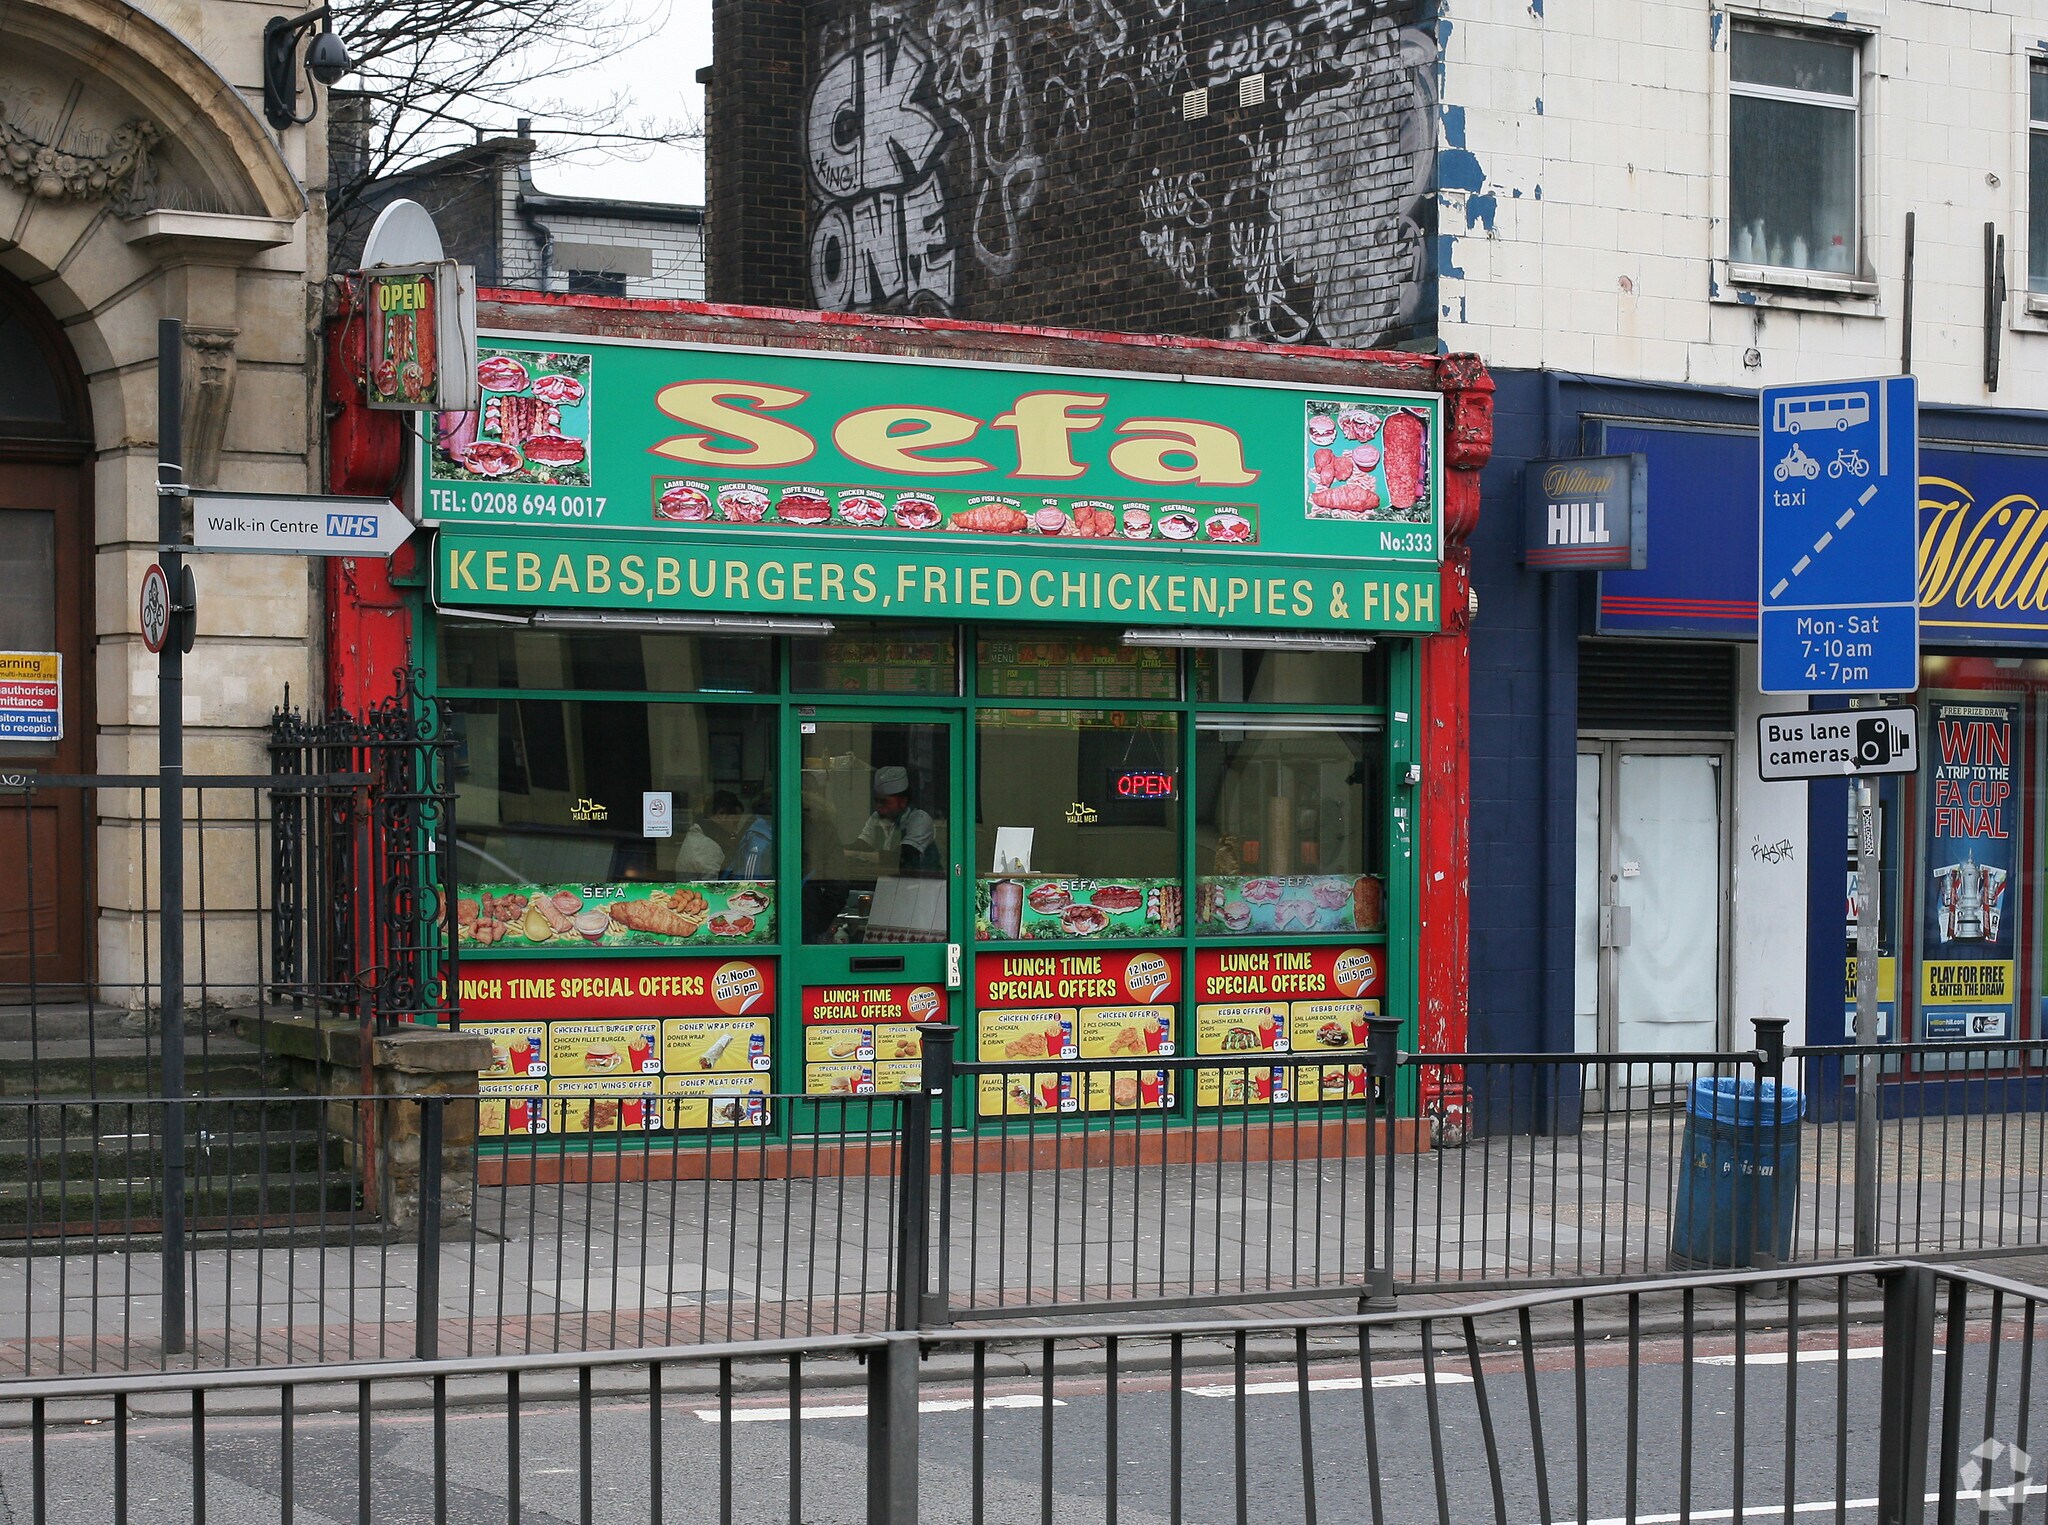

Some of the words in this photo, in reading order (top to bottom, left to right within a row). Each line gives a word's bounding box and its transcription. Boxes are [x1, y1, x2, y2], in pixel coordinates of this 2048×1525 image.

[378, 281, 427, 312] OPEN
[647, 379, 1261, 487] Sefa
[663, 480, 684, 490] LAMB
[685, 481, 710, 492] DONER
[718, 483, 746, 492] CHICKEN
[747, 484, 769, 495] DONER
[1543, 465, 1614, 499] William
[782, 487, 801, 495] KOFTE
[802, 487, 825, 497] KEBAB
[837, 489, 865, 498] CHICKEN
[865, 490, 885, 500] SHISH
[896, 491, 915, 501] LAMB
[915, 492, 936, 502] SHISH
[1774, 488, 1806, 507] taxi
[431, 489, 467, 513] TEL:
[470, 492, 518, 515] 0208
[522, 495, 557, 517] 694
[561, 497, 607, 518] 0017
[968, 497, 982, 506] COD
[981, 496, 995, 504] FISH
[996, 496, 1002, 504] &
[1002, 497, 1021, 508] CHIPS
[1042, 498, 1058, 506] PIES
[1071, 500, 1088, 510] FRIED
[1089, 500, 1115, 511] CHICKEN
[1122, 503, 1150, 512] BURGERS
[1160, 505, 1196, 515] VEGETARIAN
[1214, 507, 1240, 516] FALAFEL
[208, 517, 265, 532] Walk-in
[270, 519, 319, 534] Centre
[328, 516, 377, 537] NHS
[1548, 502, 1610, 545] HILL
[1380, 531, 1433, 554] No:333
[1329, 586, 1350, 619] &
[1364, 581, 1434, 623] FISH
[991, 653, 1014, 663] MENU
[0, 686, 57, 696] authorised
[28, 714, 51, 723] must
[1944, 706, 1962, 715] FREE
[1963, 707, 1984, 716] PRIZE
[1985, 708, 2005, 717] DRAW
[1, 723, 11, 732] to
[1768, 723, 1803, 743] Bus
[1808, 722, 1851, 741] lane
[1937, 720, 2011, 767] WIN
[1769, 746, 1850, 767] cameras
[1936, 765, 1944, 779] A
[1946, 766, 1970, 780] TRIP
[1972, 767, 1986, 780] TO
[1988, 768, 2009, 781] THE
[1117, 775, 1173, 795] OPEN
[1936, 780, 1964, 807] FA
[1968, 781, 2011, 808] CUP
[572, 812, 591, 821] HALAL
[592, 811, 608, 821] MEAT
[1066, 815, 1083, 823] HALAL
[1083, 814, 1098, 823] MEAT
[1935, 807, 2009, 839] FINAL
[1060, 879, 1098, 892] SEFA
[1277, 877, 1314, 889] SEFA
[582, 886, 626, 899] SEFA
[1003, 956, 1056, 977] LUNCH
[1060, 956, 1102, 975] TIME
[1128, 965, 1140, 976] 12
[1141, 958, 1164, 971] Noon
[1220, 953, 1269, 972] LUNCH
[1273, 952, 1312, 970] TIME
[1336, 960, 1348, 971] 12
[1348, 954, 1371, 968] Noon
[715, 973, 728, 986] 12
[728, 967, 756, 983] Noon
[1129, 978, 1144, 989] till
[1144, 974, 1151, 985] 5
[1152, 972, 1167, 984] pm
[1338, 972, 1351, 984] till
[1352, 970, 1358, 980] 5
[1359, 967, 1373, 979] pm
[1930, 966, 1956, 984] PLAY
[1957, 965, 1978, 983] FOR
[507, 978, 556, 998] TIME
[560, 977, 635, 998] SPECIAL
[638, 976, 705, 997] OFFERS
[717, 985, 733, 1001] till
[733, 984, 742, 996] 5
[742, 982, 759, 997] pm
[988, 980, 1055, 1000] SPECIAL
[1058, 978, 1117, 998] OFFERS
[1206, 975, 1268, 995] SPECIAL
[1271, 973, 1327, 993] OFFERS
[1930, 983, 1938, 997] &
[1939, 983, 1963, 997] ENTER
[1964, 983, 1978, 996] THE
[1980, 982, 2005, 996] DRAW
[823, 989, 859, 1003] LUNCH
[862, 988, 892, 1002] TIME
[813, 1005, 859, 1020] SPECIAL
[861, 1004, 902, 1018] OFFERS
[1129, 1010, 1151, 1018] OFFER
[1310, 1005, 1333, 1013] KEBAB
[1334, 1004, 1356, 1012] OFFER
[998, 1014, 1029, 1022] CHICKEN
[1031, 1013, 1053, 1021] OFFER
[483, 1027, 516, 1035] BURGER
[518, 1027, 543, 1035] OFFER
[554, 1026, 582, 1034] CHICKEN
[583, 1025, 604, 1033] FILLET
[606, 1025, 633, 1033] BURGER
[635, 1024, 656, 1032] OFFER
[679, 1023, 704, 1031] DONER
[707, 1022, 730, 1031] WRAP
[732, 1021, 755, 1030] OFFER
[515, 1084, 540, 1092] OFFER
[558, 1083, 581, 1091] SPICY
[583, 1082, 598, 1090] HOT
[600, 1081, 627, 1089] WINGS
[628, 1080, 653, 1089] OFFER
[680, 1079, 706, 1087] DONER
[708, 1079, 728, 1087] MEAT
[731, 1077, 754, 1085] OFFER
